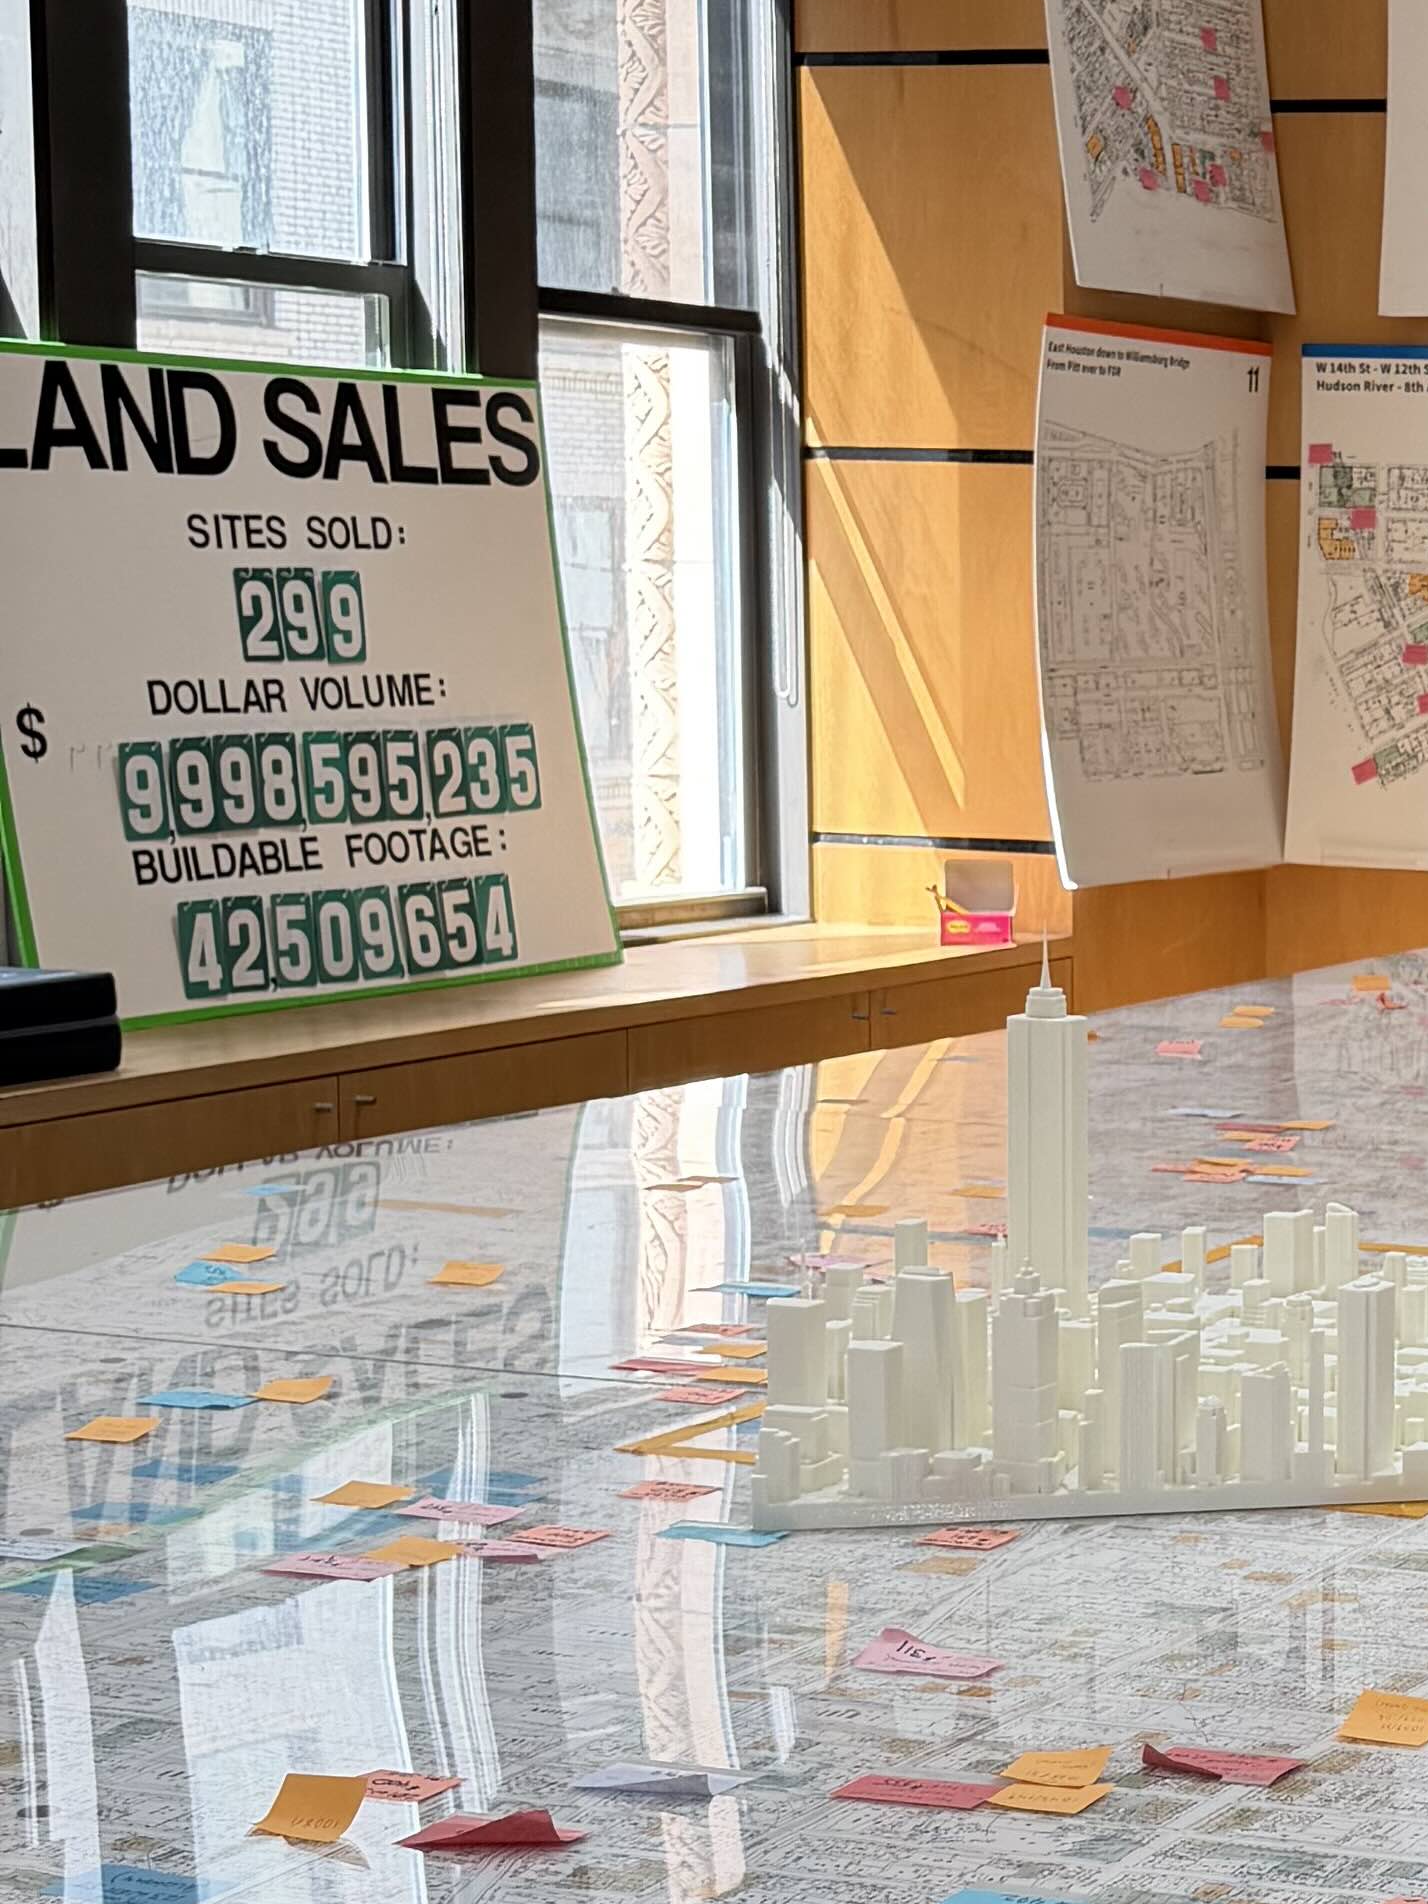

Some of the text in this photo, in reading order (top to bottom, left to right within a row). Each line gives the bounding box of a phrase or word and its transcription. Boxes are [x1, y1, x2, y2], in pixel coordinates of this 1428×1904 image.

[1248, 366, 1260, 392] 11
[1316, 363, 1327, 374] W
[1330, 362, 1356, 374] 14th
[1359, 362, 1371, 375] St
[1380, 363, 1392, 375] W
[1394, 363, 1421, 375] 12th
[1316, 380, 1360, 392] Hudson
[1363, 380, 1394, 393] River
[1404, 381, 1423, 393] 8th
[0, 360, 541, 487] AND SALES
[187, 514, 407, 550] SITES SOLD:
[242, 577, 364, 662] 299
[147, 674, 447, 716] DOLLAR VOLUME:
[15, 702, 48, 762] $
[132, 824, 508, 886] BUILDABLE FOOTAGE:
